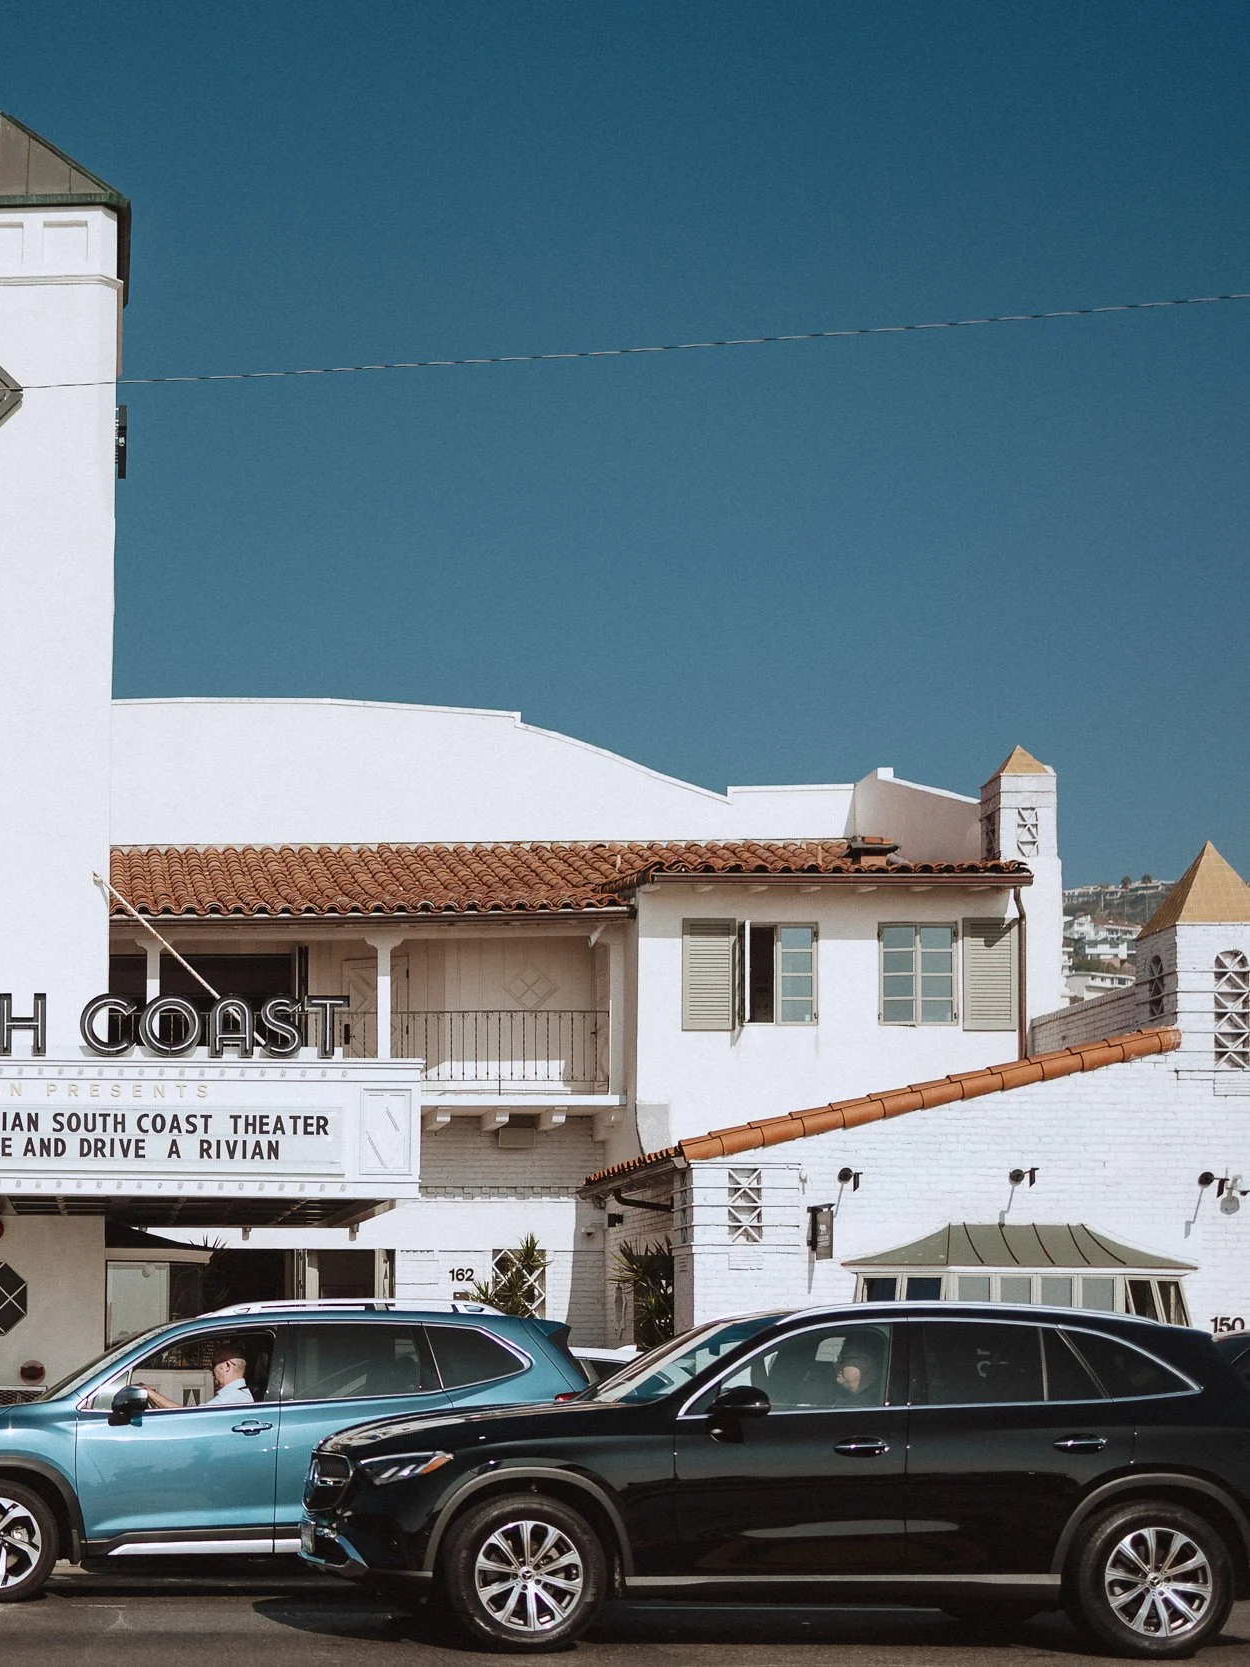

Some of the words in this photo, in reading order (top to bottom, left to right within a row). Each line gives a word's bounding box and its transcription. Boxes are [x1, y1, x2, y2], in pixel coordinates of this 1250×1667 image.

[80, 993, 349, 1058] COAST
[46, 1083, 208, 1098] PRESENTS
[52, 1112, 126, 1133] SOUTH
[136, 1113, 213, 1135] COAST
[229, 1114, 329, 1136] THEATER
[23, 1137, 67, 1158] AND
[79, 1138, 146, 1159] DRIVE
[167, 1139, 182, 1159] A
[199, 1139, 280, 1160] RIVIAN
[449, 1268, 475, 1281] 162
[1210, 1316, 1245, 1333] 150
